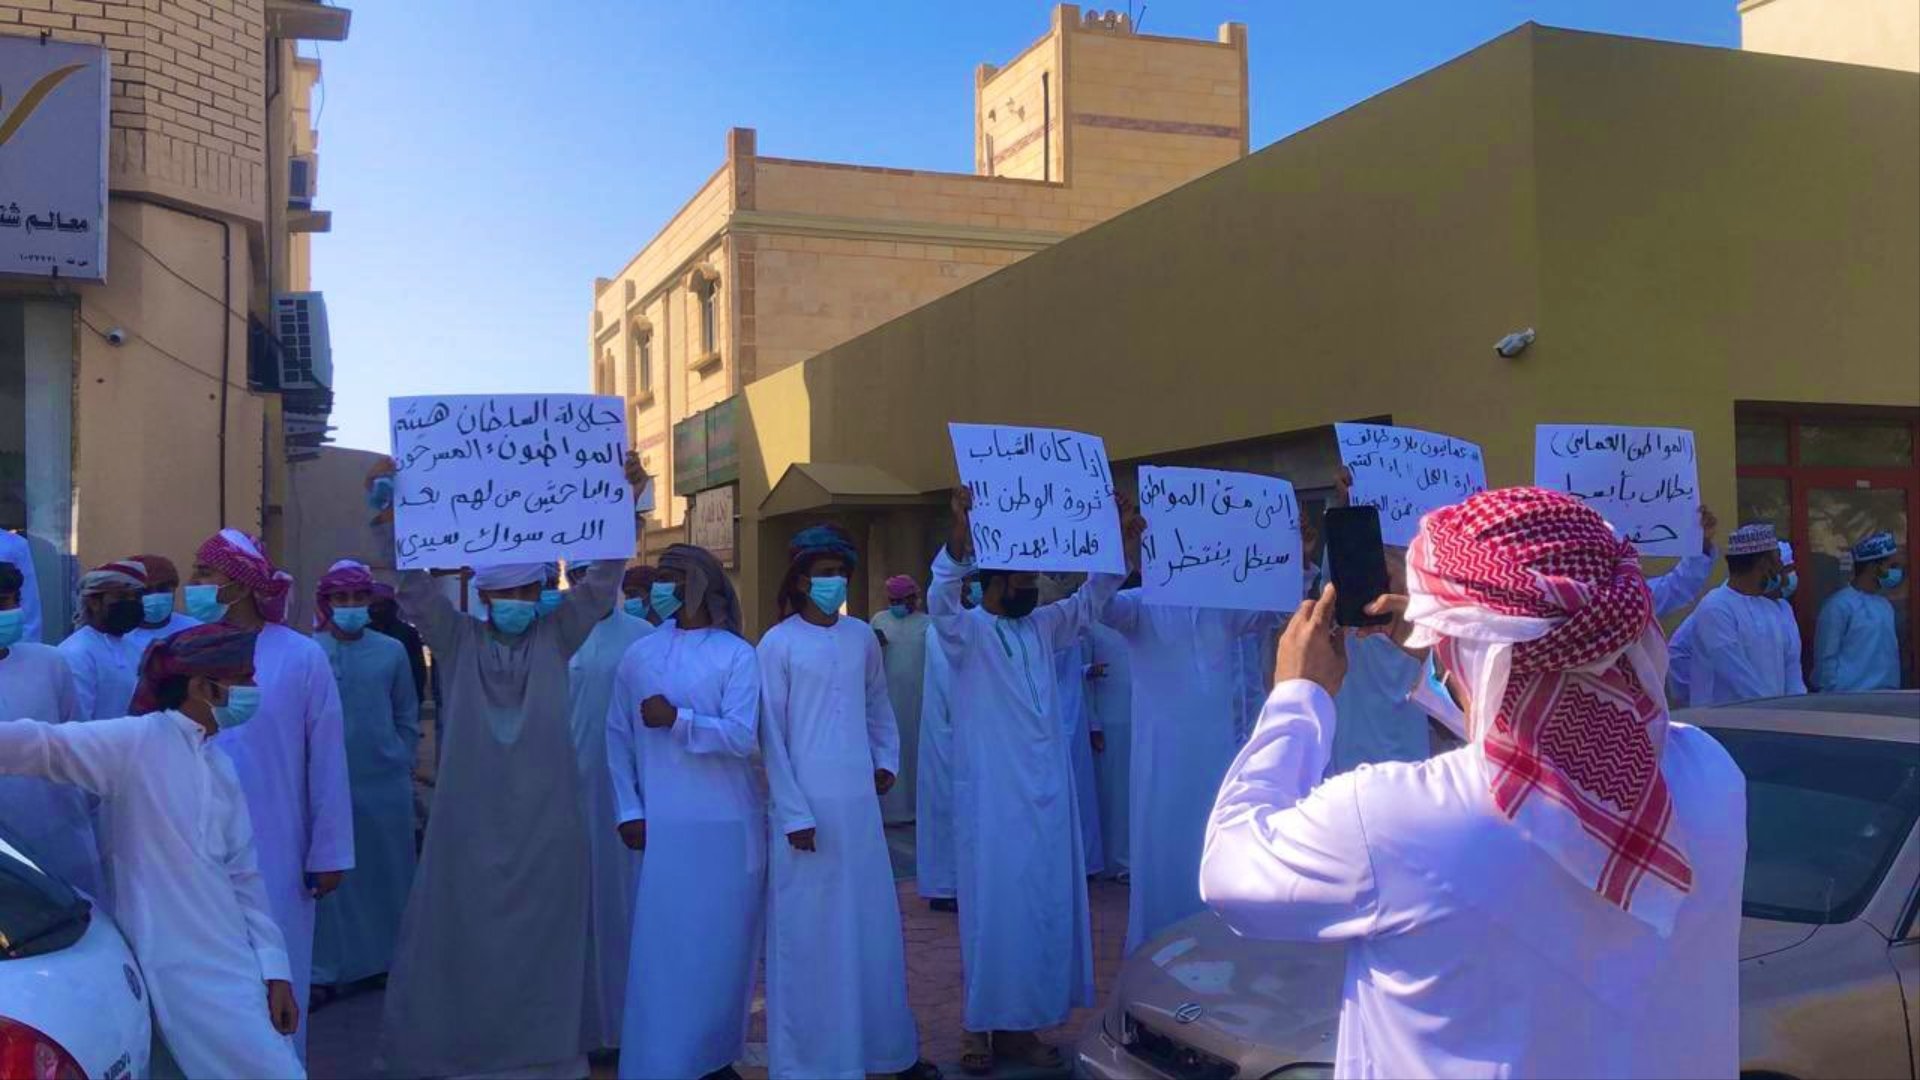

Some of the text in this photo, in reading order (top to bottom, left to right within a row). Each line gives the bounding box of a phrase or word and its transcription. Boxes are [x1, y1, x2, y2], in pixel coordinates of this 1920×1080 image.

[26, 211, 88, 233] معالم
[394, 398, 622, 449] جلالة السلطان هيثم
[969, 429, 1035, 463] الشباب
[1040, 431, 1071, 462] كان
[400, 478, 624, 523] والباحثين من لهم بعد
[998, 475, 1053, 520] الوطن
[1063, 487, 1101, 522] ثروة
[1141, 474, 1204, 513] المواطن
[397, 519, 604, 565] الله سواك سيدي
[1053, 527, 1099, 557] فلماذا
[1160, 528, 1231, 587] ينتظر
[1234, 544, 1290, 583] سيظل
